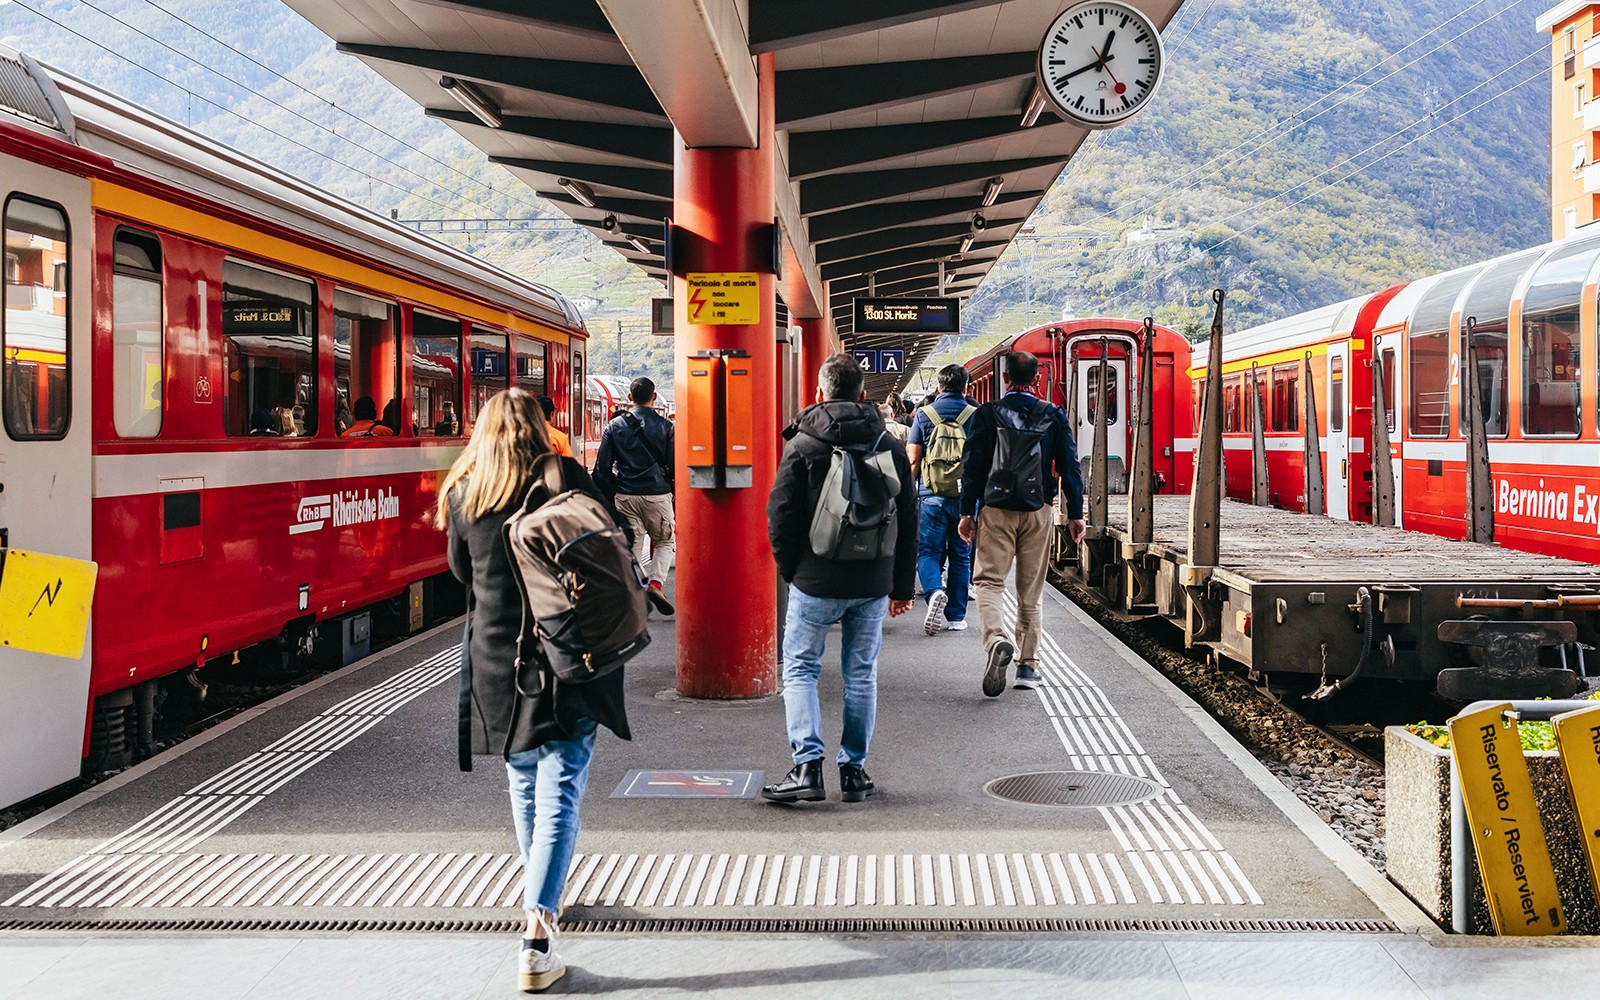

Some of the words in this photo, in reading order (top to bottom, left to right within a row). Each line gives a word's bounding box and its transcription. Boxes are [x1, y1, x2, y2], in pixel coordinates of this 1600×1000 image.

[197, 280, 209, 356] 1
[865, 310, 883, 320] 13:00
[884, 310, 894, 320] St.
[895, 310, 918, 320] Moritz
[860, 356, 870, 371] 4
[886, 356, 898, 371] A
[1451, 352, 1459, 385] 2
[302, 506, 320, 521] RhB
[333, 488, 376, 527] Rhätische
[378, 486, 399, 520] Bahn
[1498, 478, 1568, 521] Bernina
[1573, 484, 1600, 535] Ex
[1480, 723, 1510, 811] Riservato
[1504, 828, 1541, 926] Reserviert
